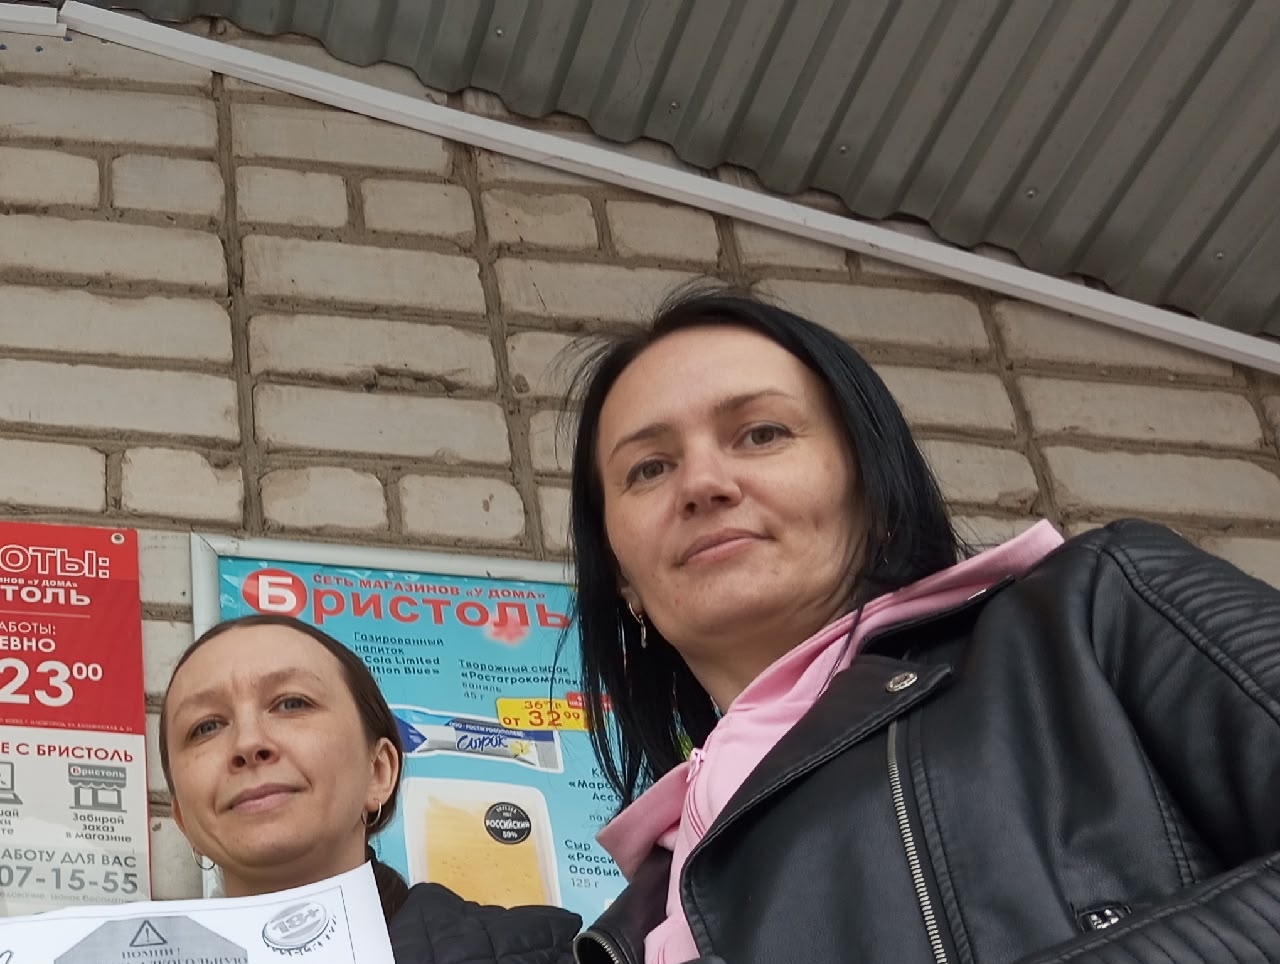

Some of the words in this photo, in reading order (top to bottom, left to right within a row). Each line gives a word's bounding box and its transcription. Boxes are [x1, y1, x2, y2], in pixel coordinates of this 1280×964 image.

[313, 574, 354, 588] СЕТЬ
[359, 578, 461, 597] МАГАЗИНОВ
[249, 571, 570, 628] Бристоль
[354, 631, 444, 646] Газированный
[363, 656, 392, 665] Cola
[459, 659, 528, 673] Творожный
[16, 743, 30, 756] С
[36, 745, 134, 763] БРИСТОЛЬ
[73, 813, 125, 825] Забирай
[565, 839, 591, 851] Сыр
[60, 852, 96, 866] ДЛЯ
[101, 855, 137, 868] ВАС
[568, 852, 616, 865] «Росси
[569, 864, 620, 877] Особый
